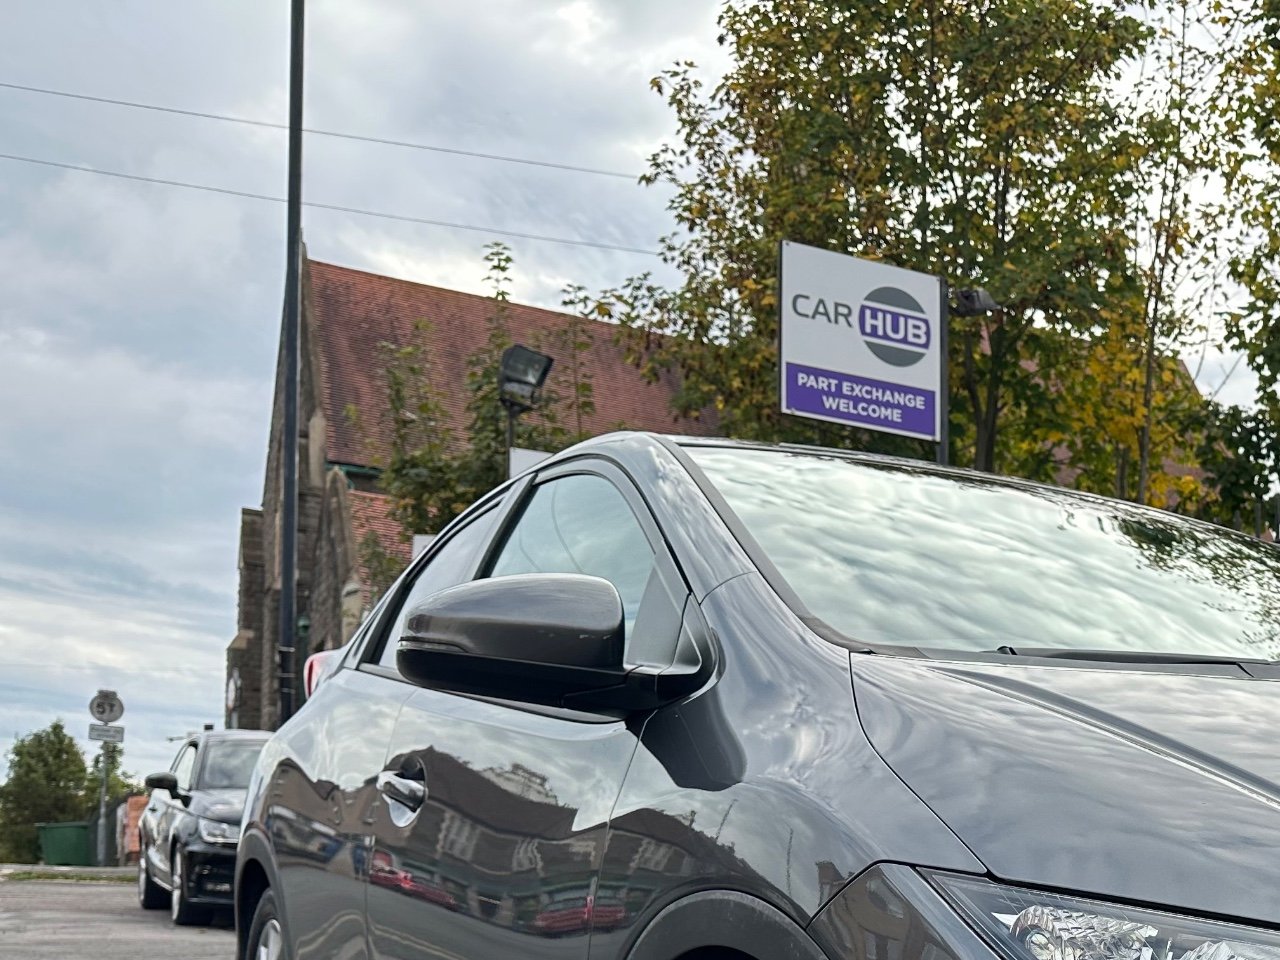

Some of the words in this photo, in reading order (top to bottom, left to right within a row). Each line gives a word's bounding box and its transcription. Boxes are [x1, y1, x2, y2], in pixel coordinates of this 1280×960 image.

[791, 293, 854, 329] CAR
[864, 308, 928, 345] HUB
[797, 372, 839, 393] PART
[842, 382, 926, 410] EXCHANGE
[822, 395, 903, 423] WELCOME
